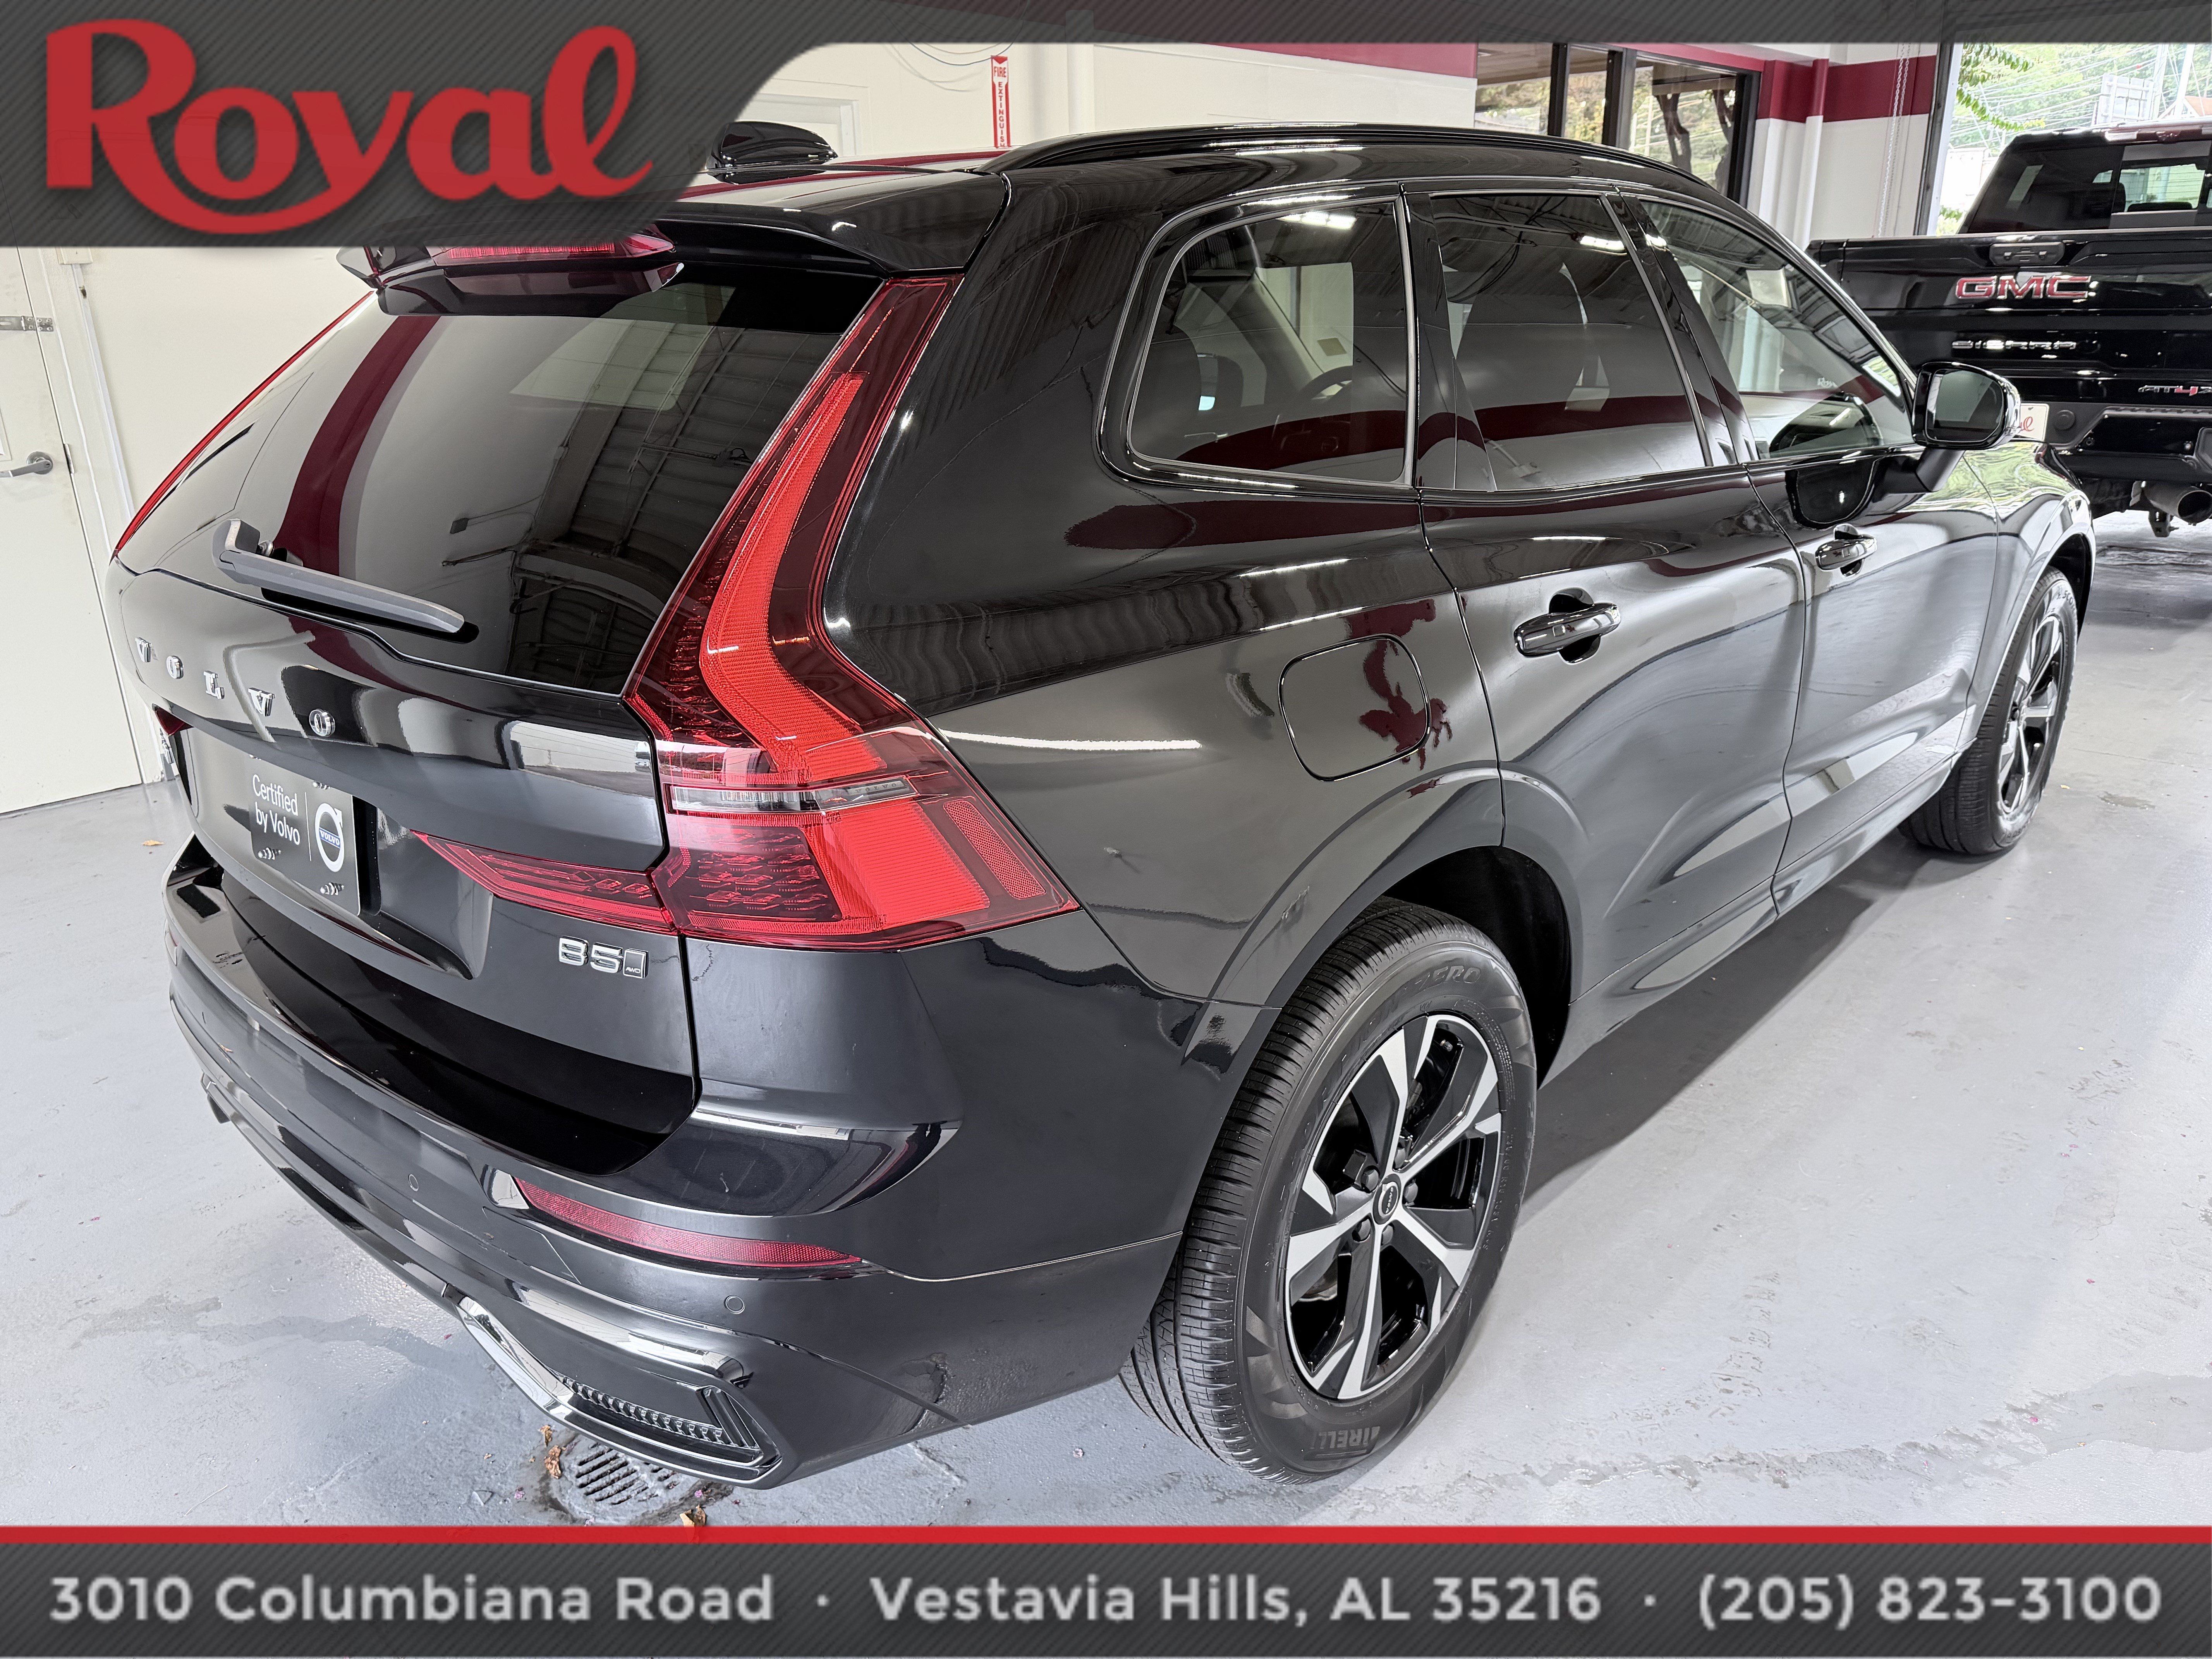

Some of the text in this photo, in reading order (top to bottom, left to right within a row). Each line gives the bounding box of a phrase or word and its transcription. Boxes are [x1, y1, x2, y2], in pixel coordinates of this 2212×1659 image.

[994, 66, 1007, 78] FIRE
[1955, 275, 2092, 299] GMC
[135, 637, 336, 737] VOLVO
[252, 774, 298, 816] Certified
[255, 801, 300, 845] by Volvo
[319, 829, 340, 846] VOLVO
[558, 936, 623, 974] B5
